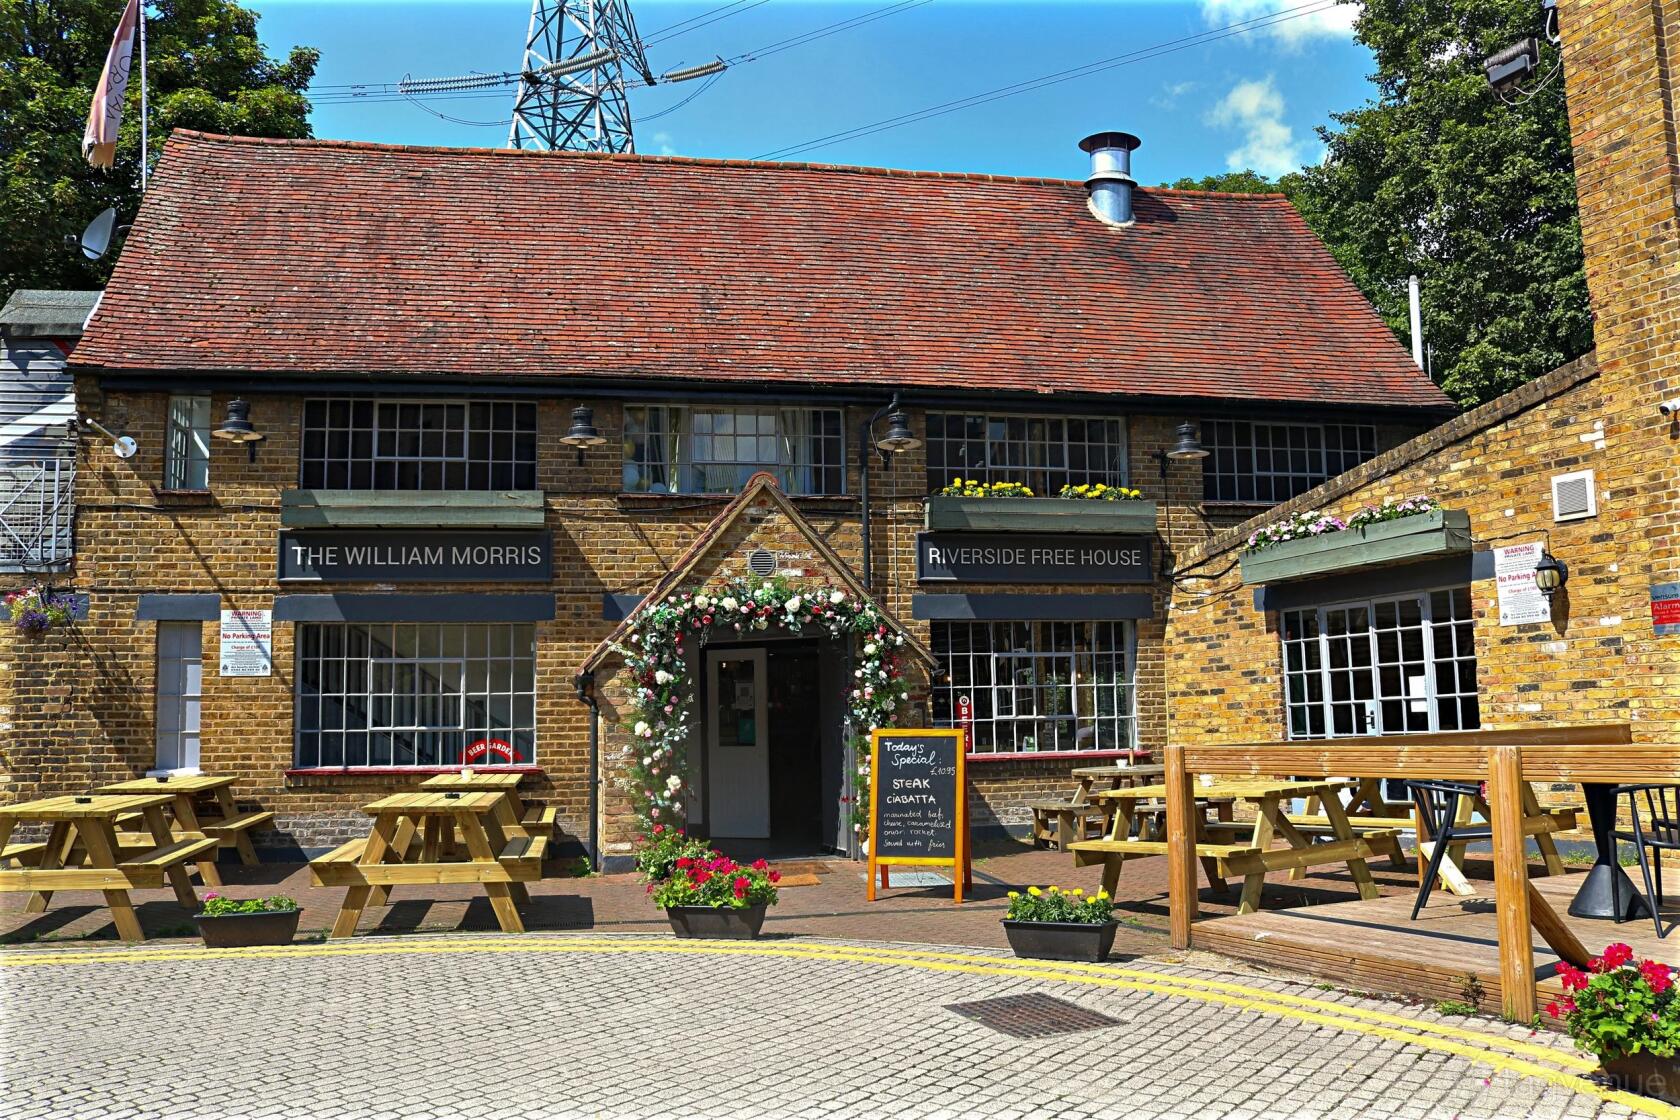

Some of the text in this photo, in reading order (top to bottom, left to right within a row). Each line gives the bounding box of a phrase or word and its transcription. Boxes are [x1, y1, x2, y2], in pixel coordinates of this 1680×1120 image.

[291, 546, 542, 565] THE WILLIAM MORRIS
[1504, 545, 1535, 555] WARNING
[929, 547, 1142, 566] RIVERSIDE FREE HOUSE
[1508, 573, 1531, 581] Parking
[467, 743, 486, 756] BEER
[884, 741, 925, 757] Today's
[930, 766, 956, 776] £10.95
[892, 778, 931, 790] STEAK
[906, 839, 922, 847] with
